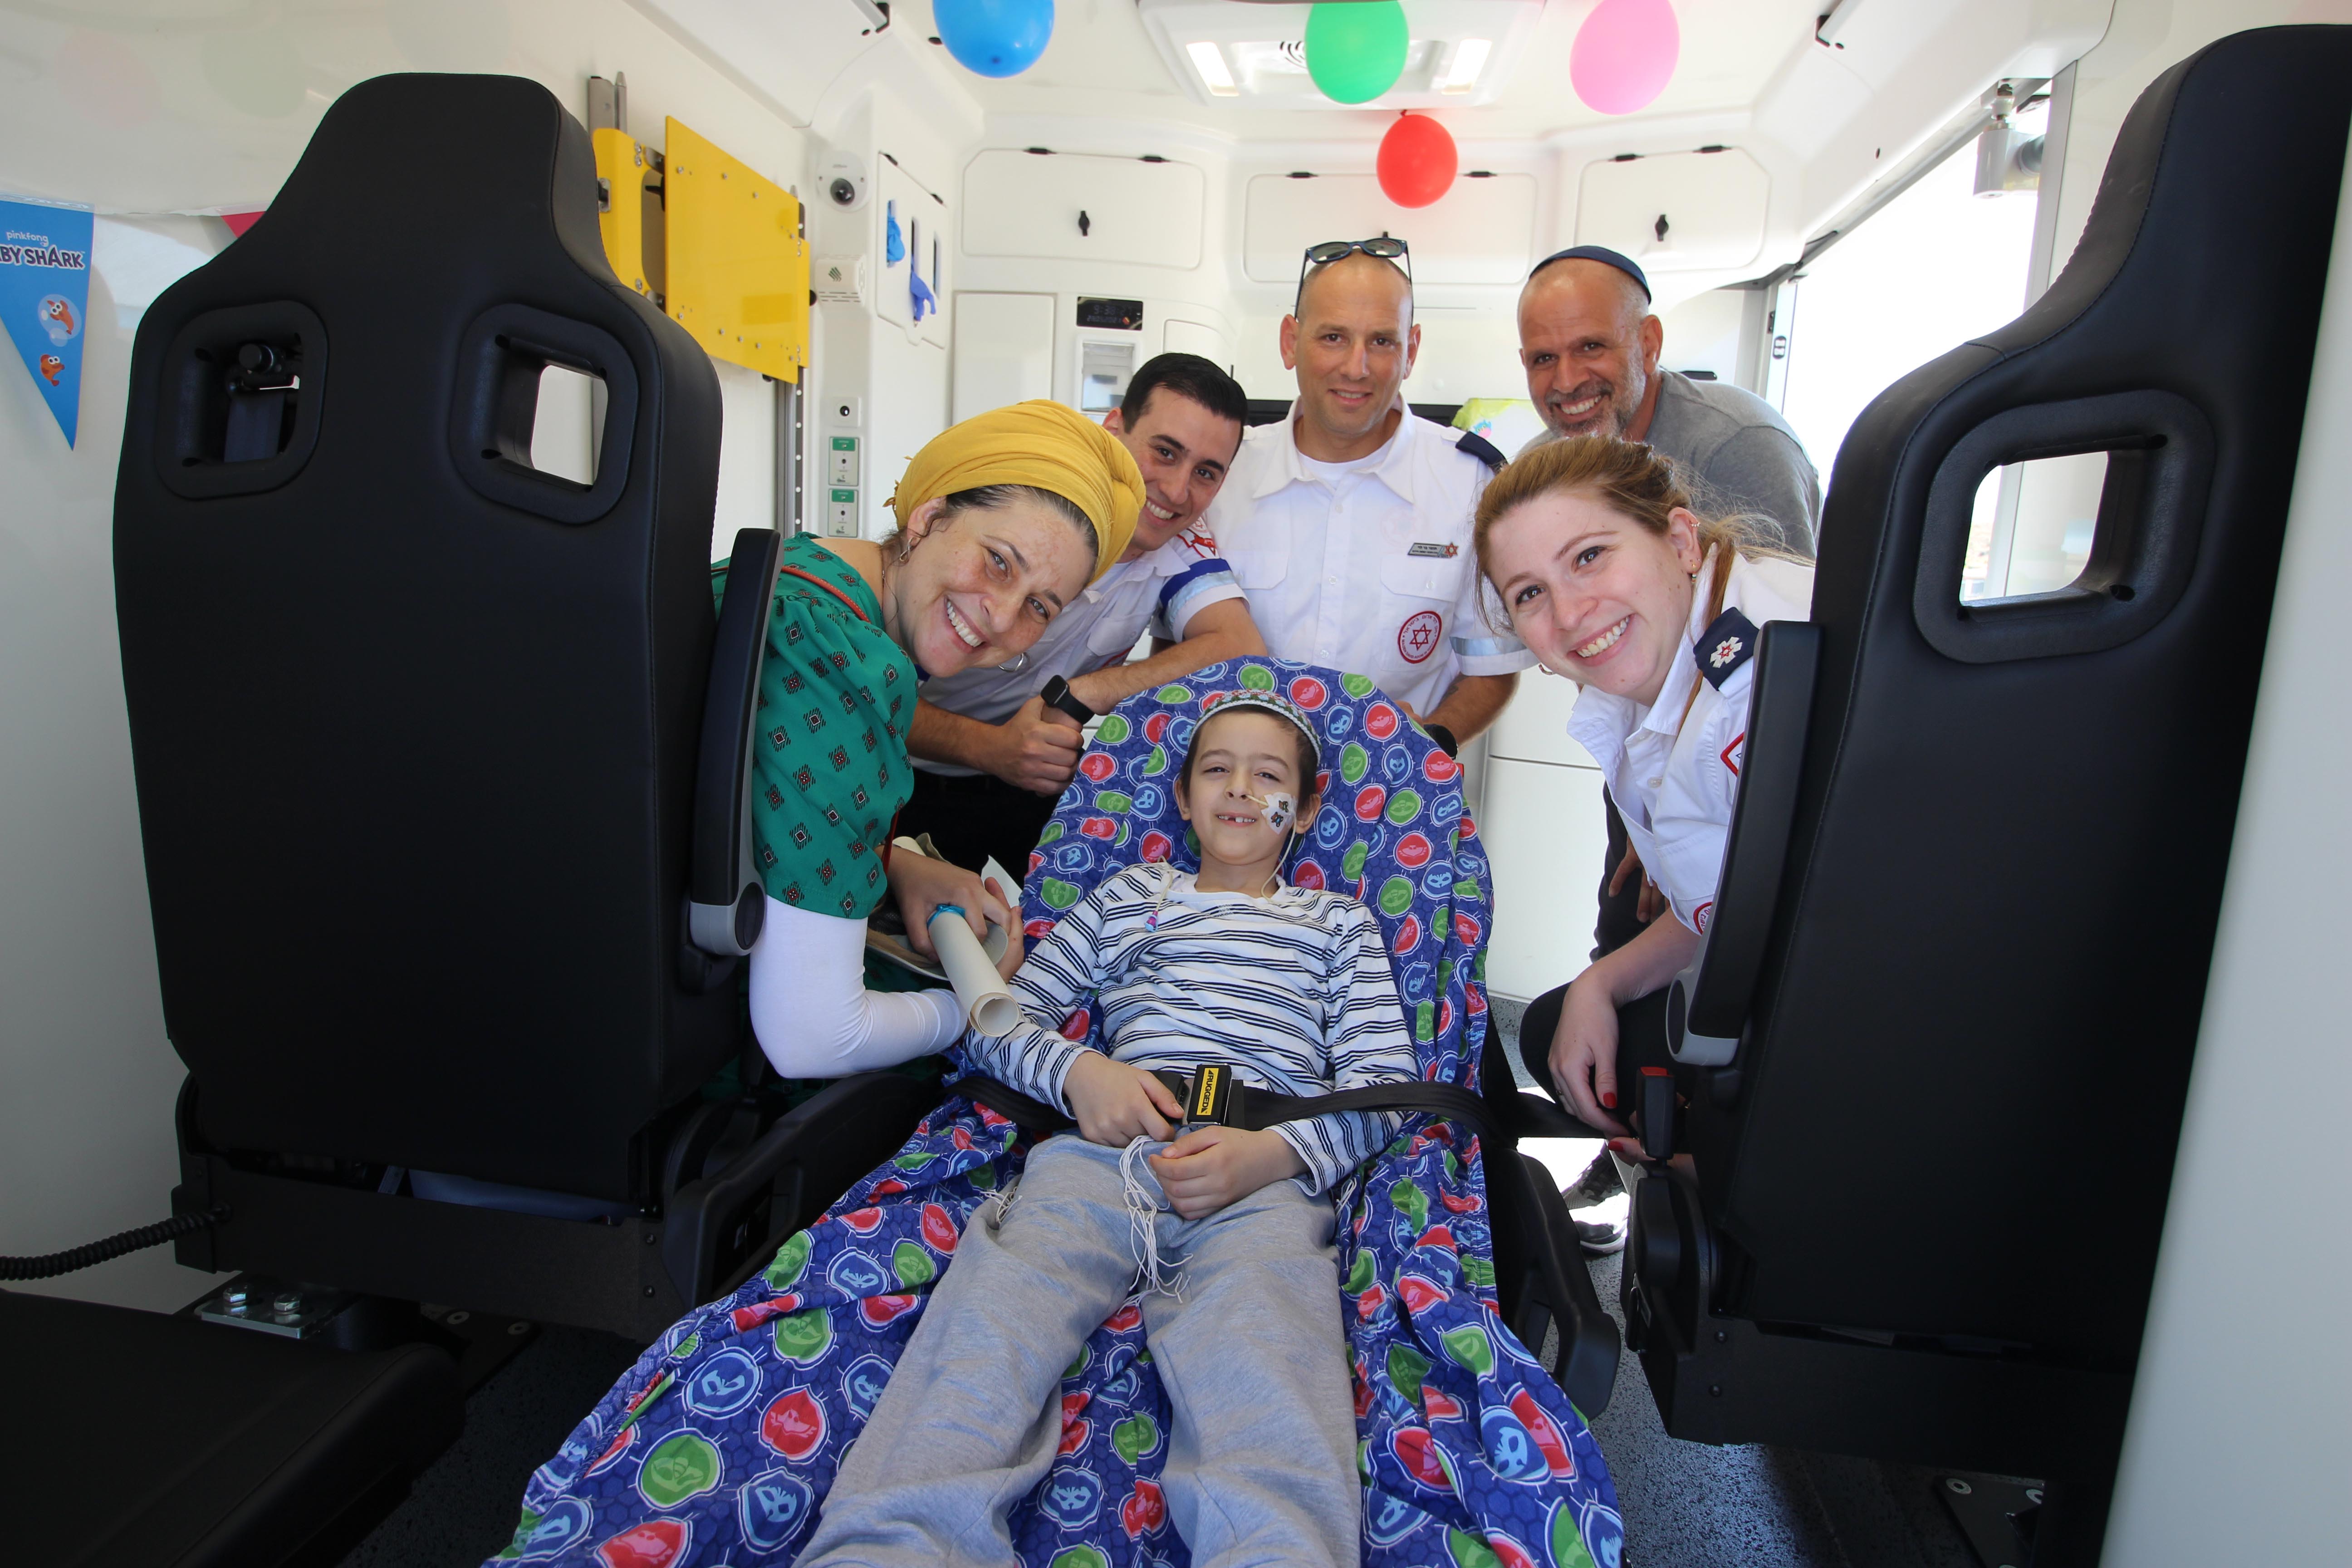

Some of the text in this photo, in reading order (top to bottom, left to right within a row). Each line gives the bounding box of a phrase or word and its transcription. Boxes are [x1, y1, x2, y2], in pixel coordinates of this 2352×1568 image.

[6, 230, 49, 247] pinkfong
[24, 246, 85, 269] SHARK
[1403, 617, 1419, 634] בישראל
[1202, 1075, 1214, 1108] RUGGED
